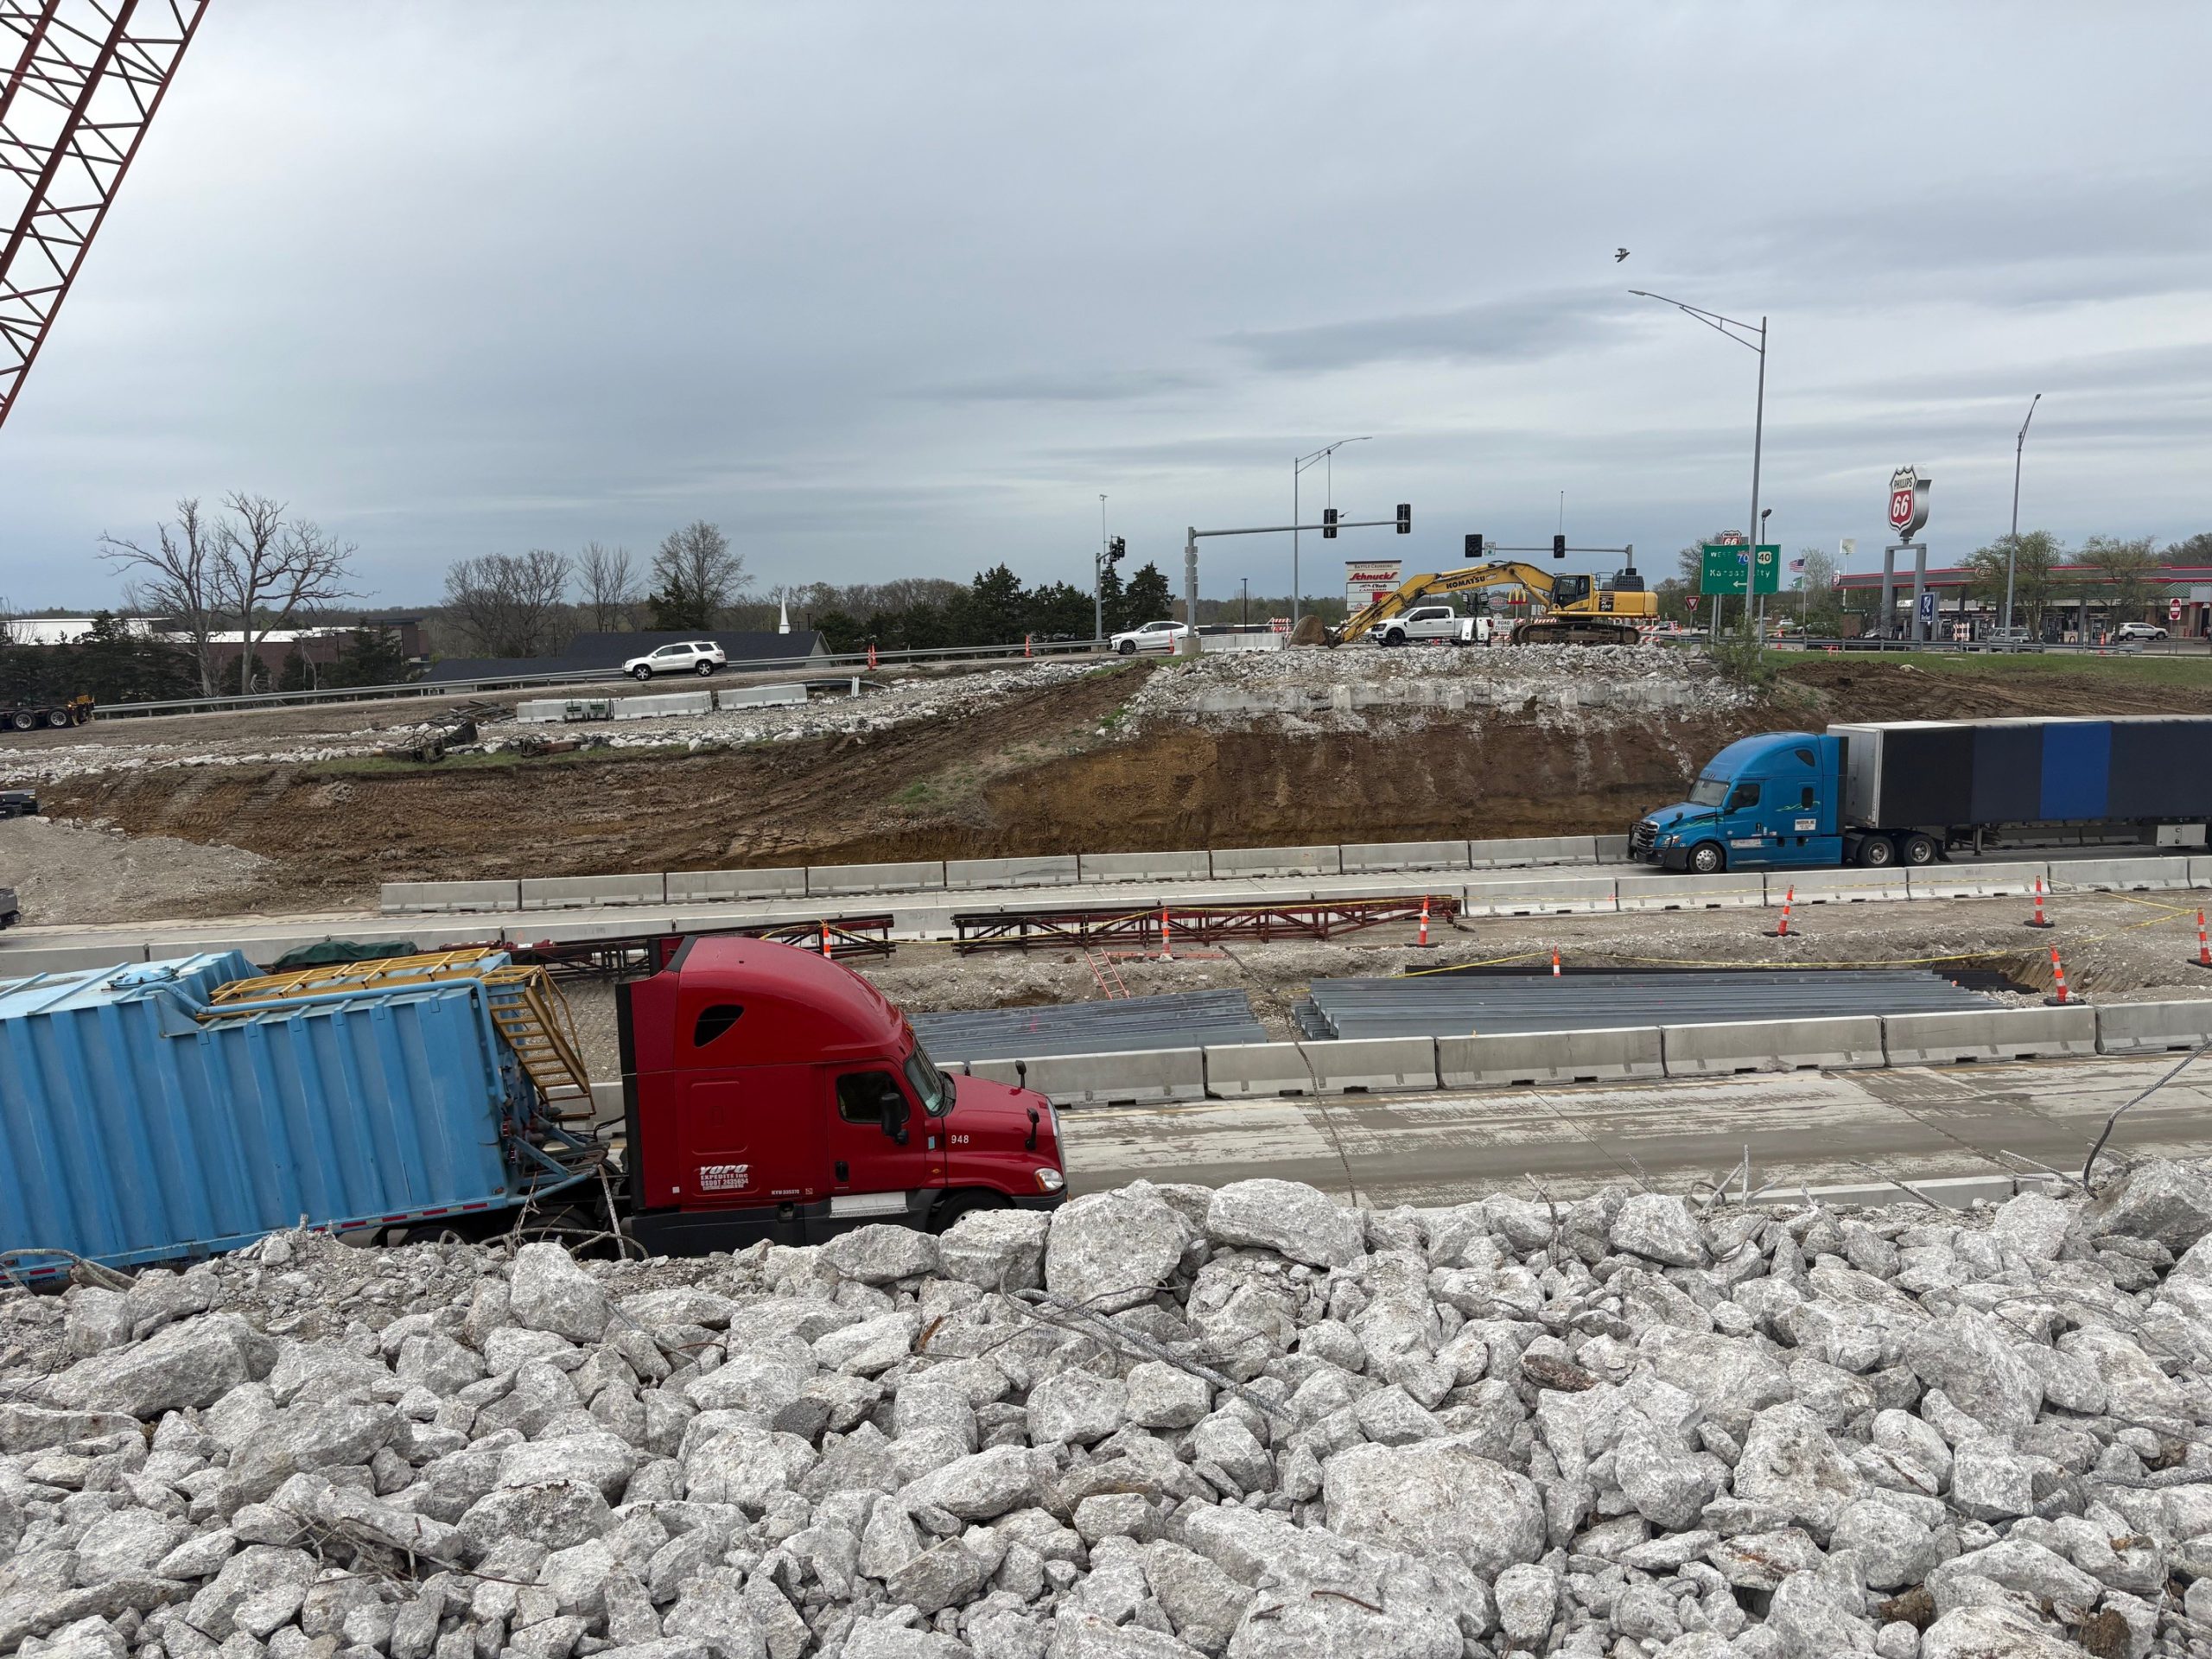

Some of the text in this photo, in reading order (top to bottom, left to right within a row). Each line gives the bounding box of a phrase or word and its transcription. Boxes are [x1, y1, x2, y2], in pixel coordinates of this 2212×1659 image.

[1894, 477, 1912, 490] PHILLIPS
[1893, 494, 1910, 518] 66
[1737, 554, 1749, 563] 70
[1758, 553, 1770, 562] 40
[1349, 571, 1398, 581] Schnucks
[1446, 575, 1486, 589] KOMATSU
[951, 1135, 969, 1144] 948
[700, 1164, 749, 1175] YOPO
